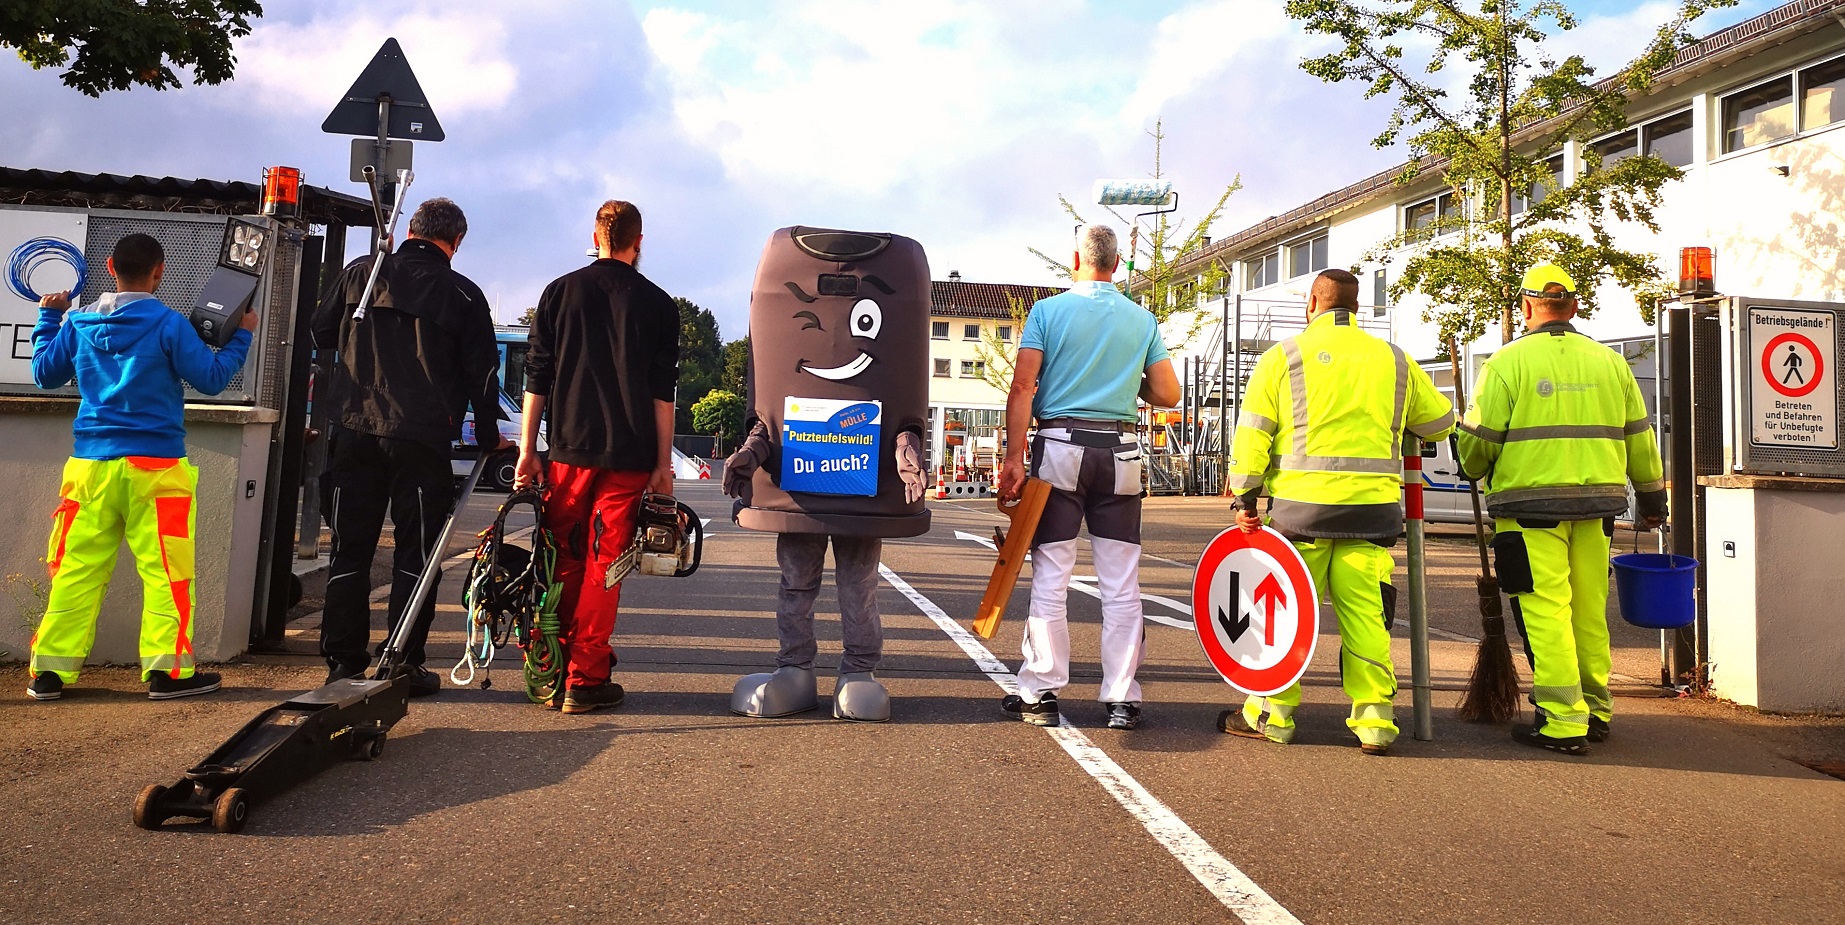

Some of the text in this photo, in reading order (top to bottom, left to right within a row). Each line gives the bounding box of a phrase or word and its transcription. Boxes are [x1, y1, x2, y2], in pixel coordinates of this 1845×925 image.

[1755, 314, 1824, 329] Betriebsgelände
[1775, 400, 1812, 410] Betreten
[840, 412, 868, 429] MÜLLE
[1765, 411, 1823, 421] und Befahren
[1764, 421, 1824, 433] für Unbefugte
[789, 430, 874, 445] Putzteufelswild!
[1773, 432, 1811, 442] verboten
[793, 453, 870, 474] Du auch?
